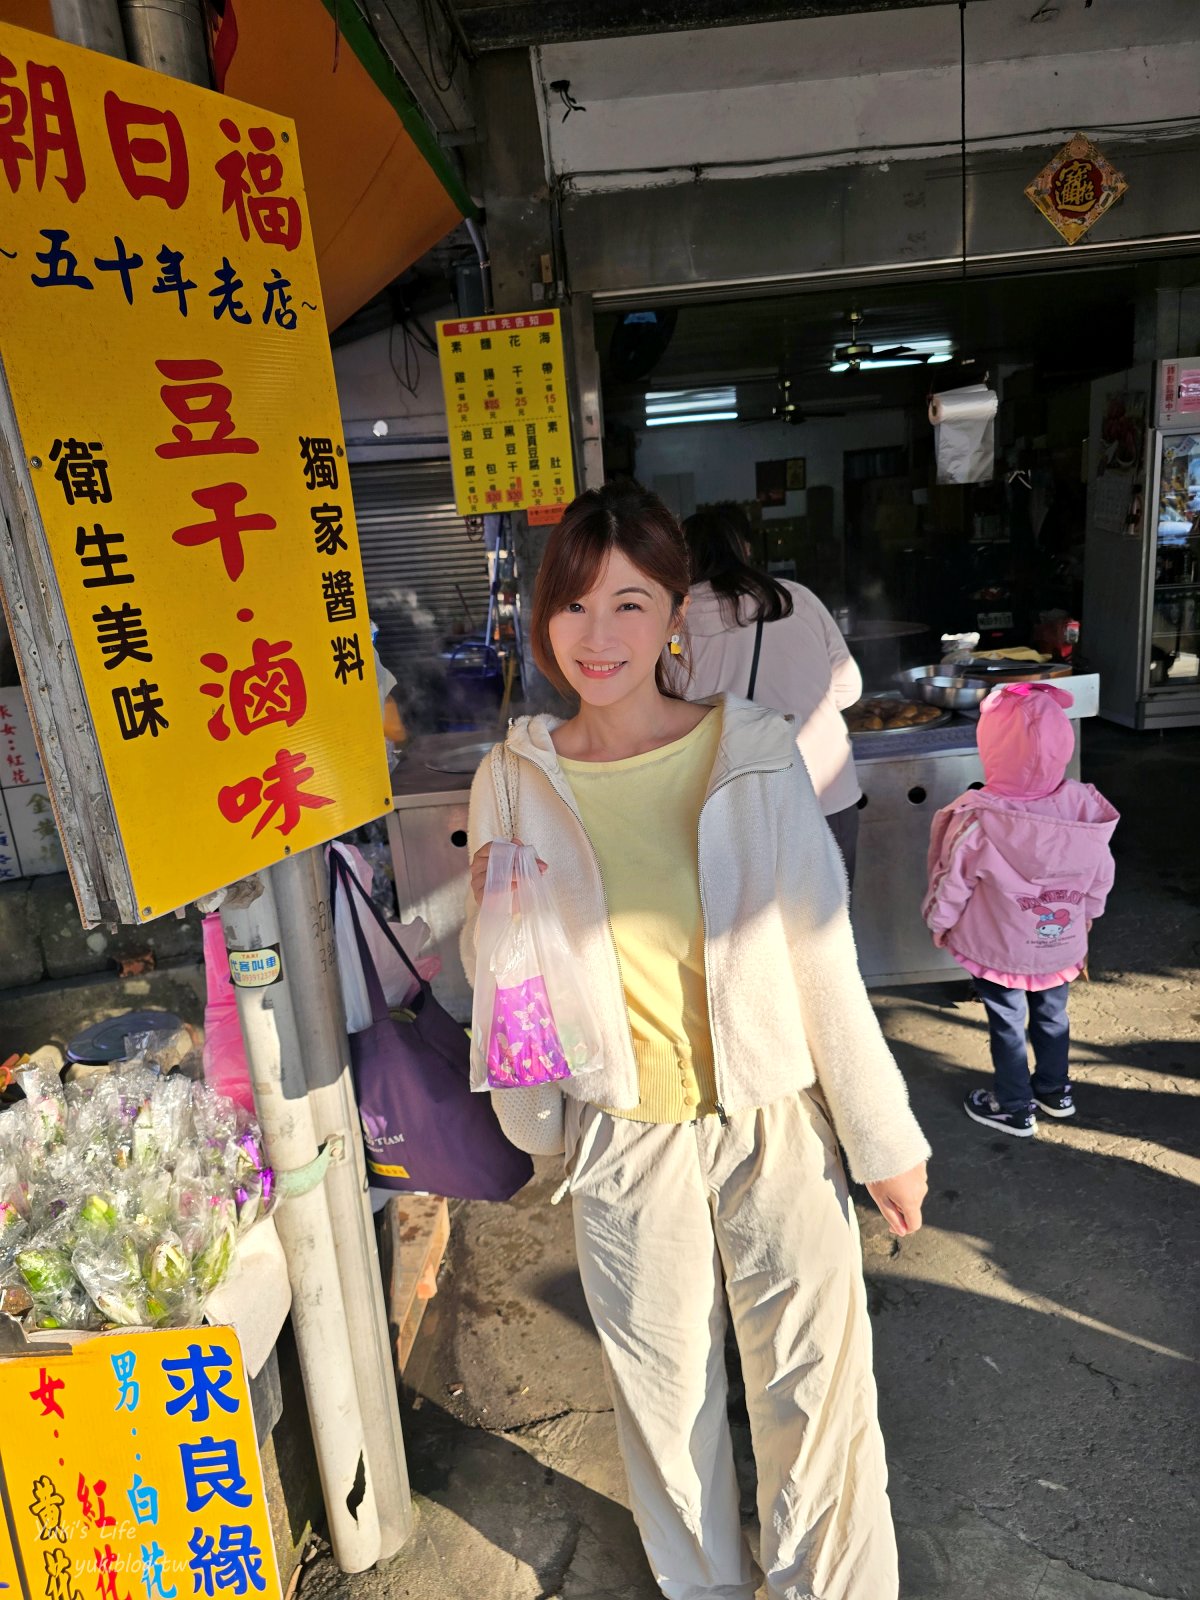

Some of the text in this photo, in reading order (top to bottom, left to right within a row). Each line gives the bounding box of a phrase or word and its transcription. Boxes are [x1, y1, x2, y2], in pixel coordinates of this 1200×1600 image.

[0, 53, 302, 252] 朝日福
[458, 316, 540, 333] 吃素請先告知
[48, 437, 169, 741] 衛生美味
[298, 435, 365, 686] 獨家醬料
[161, 1344, 267, 1598] 求良緣
